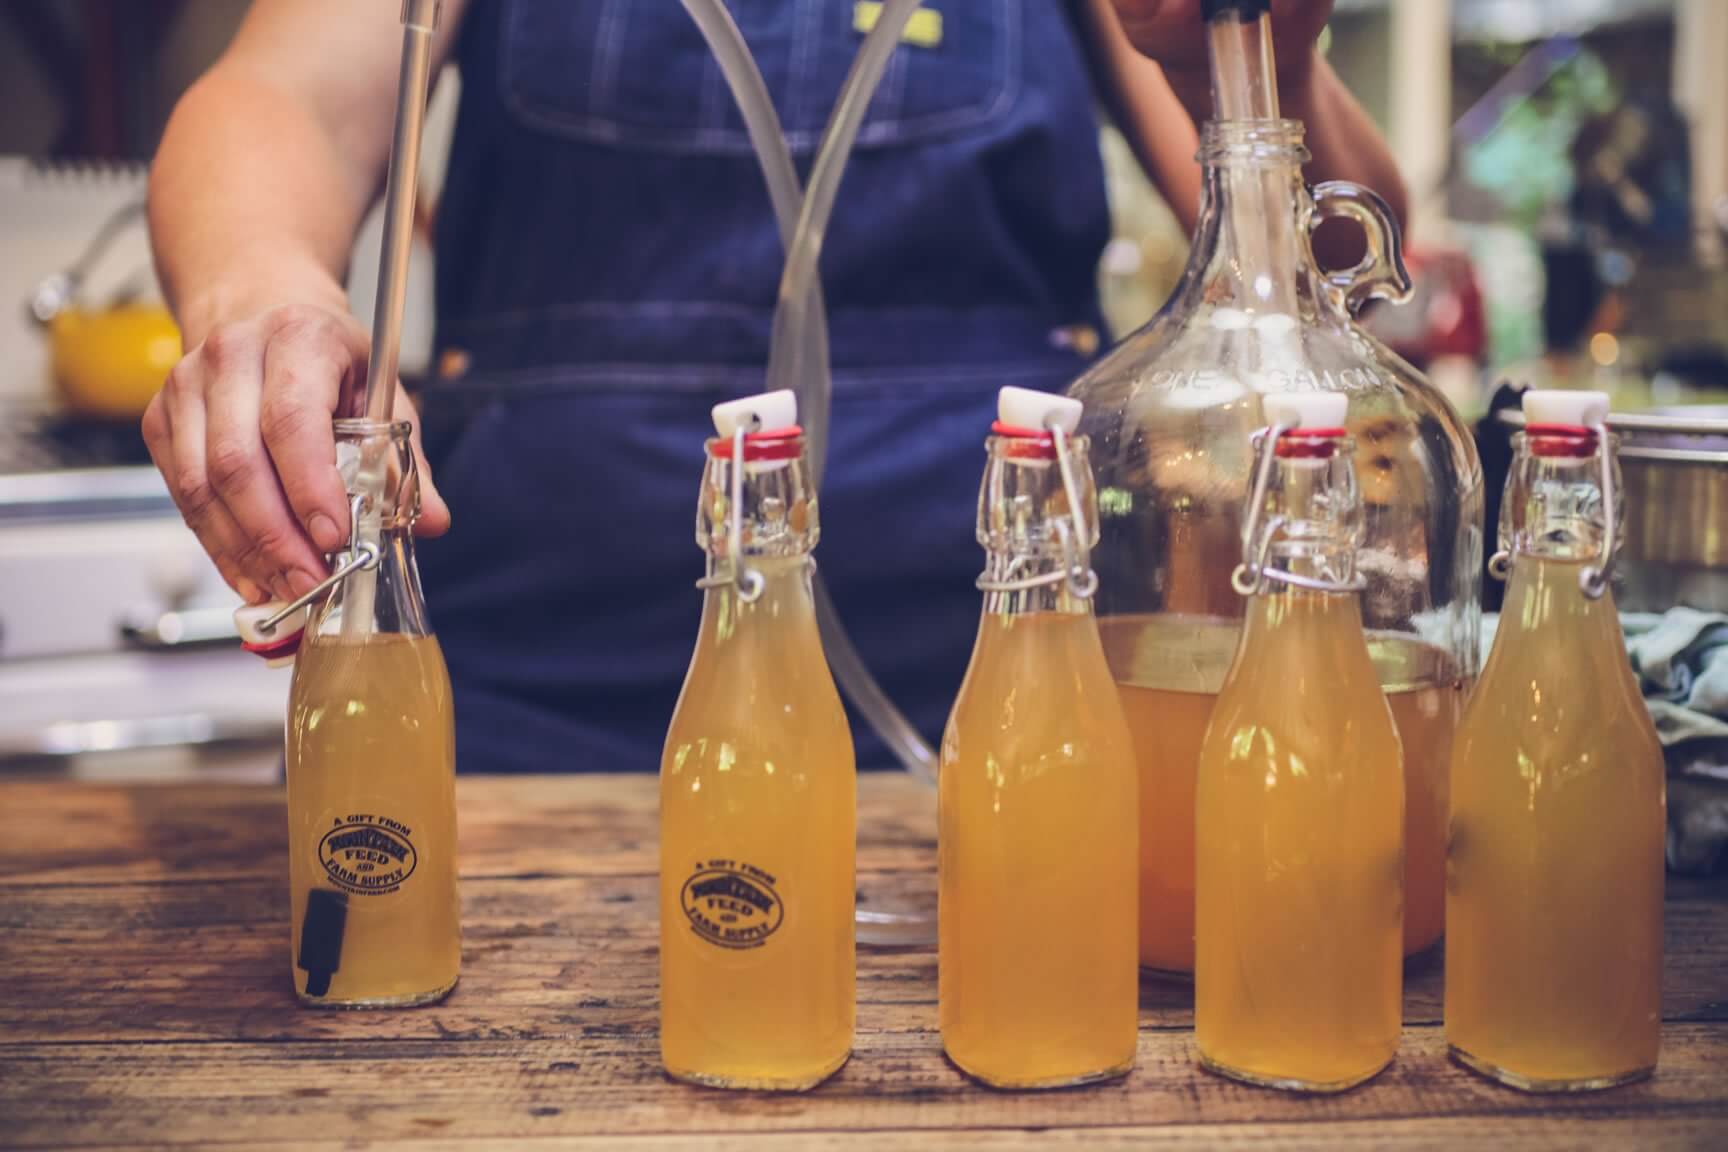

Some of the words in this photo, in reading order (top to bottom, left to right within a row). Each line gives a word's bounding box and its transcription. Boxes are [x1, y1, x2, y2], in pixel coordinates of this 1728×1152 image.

[1151, 368, 1219, 391] ONE
[334, 817, 342, 826] A
[346, 815, 374, 823] GIFT
[379, 816, 412, 836] FROM
[345, 850, 389, 865] FEED
[327, 858, 358, 883] FARM
[361, 869, 404, 885] SUPPLY
[707, 898, 753, 917] FEED
